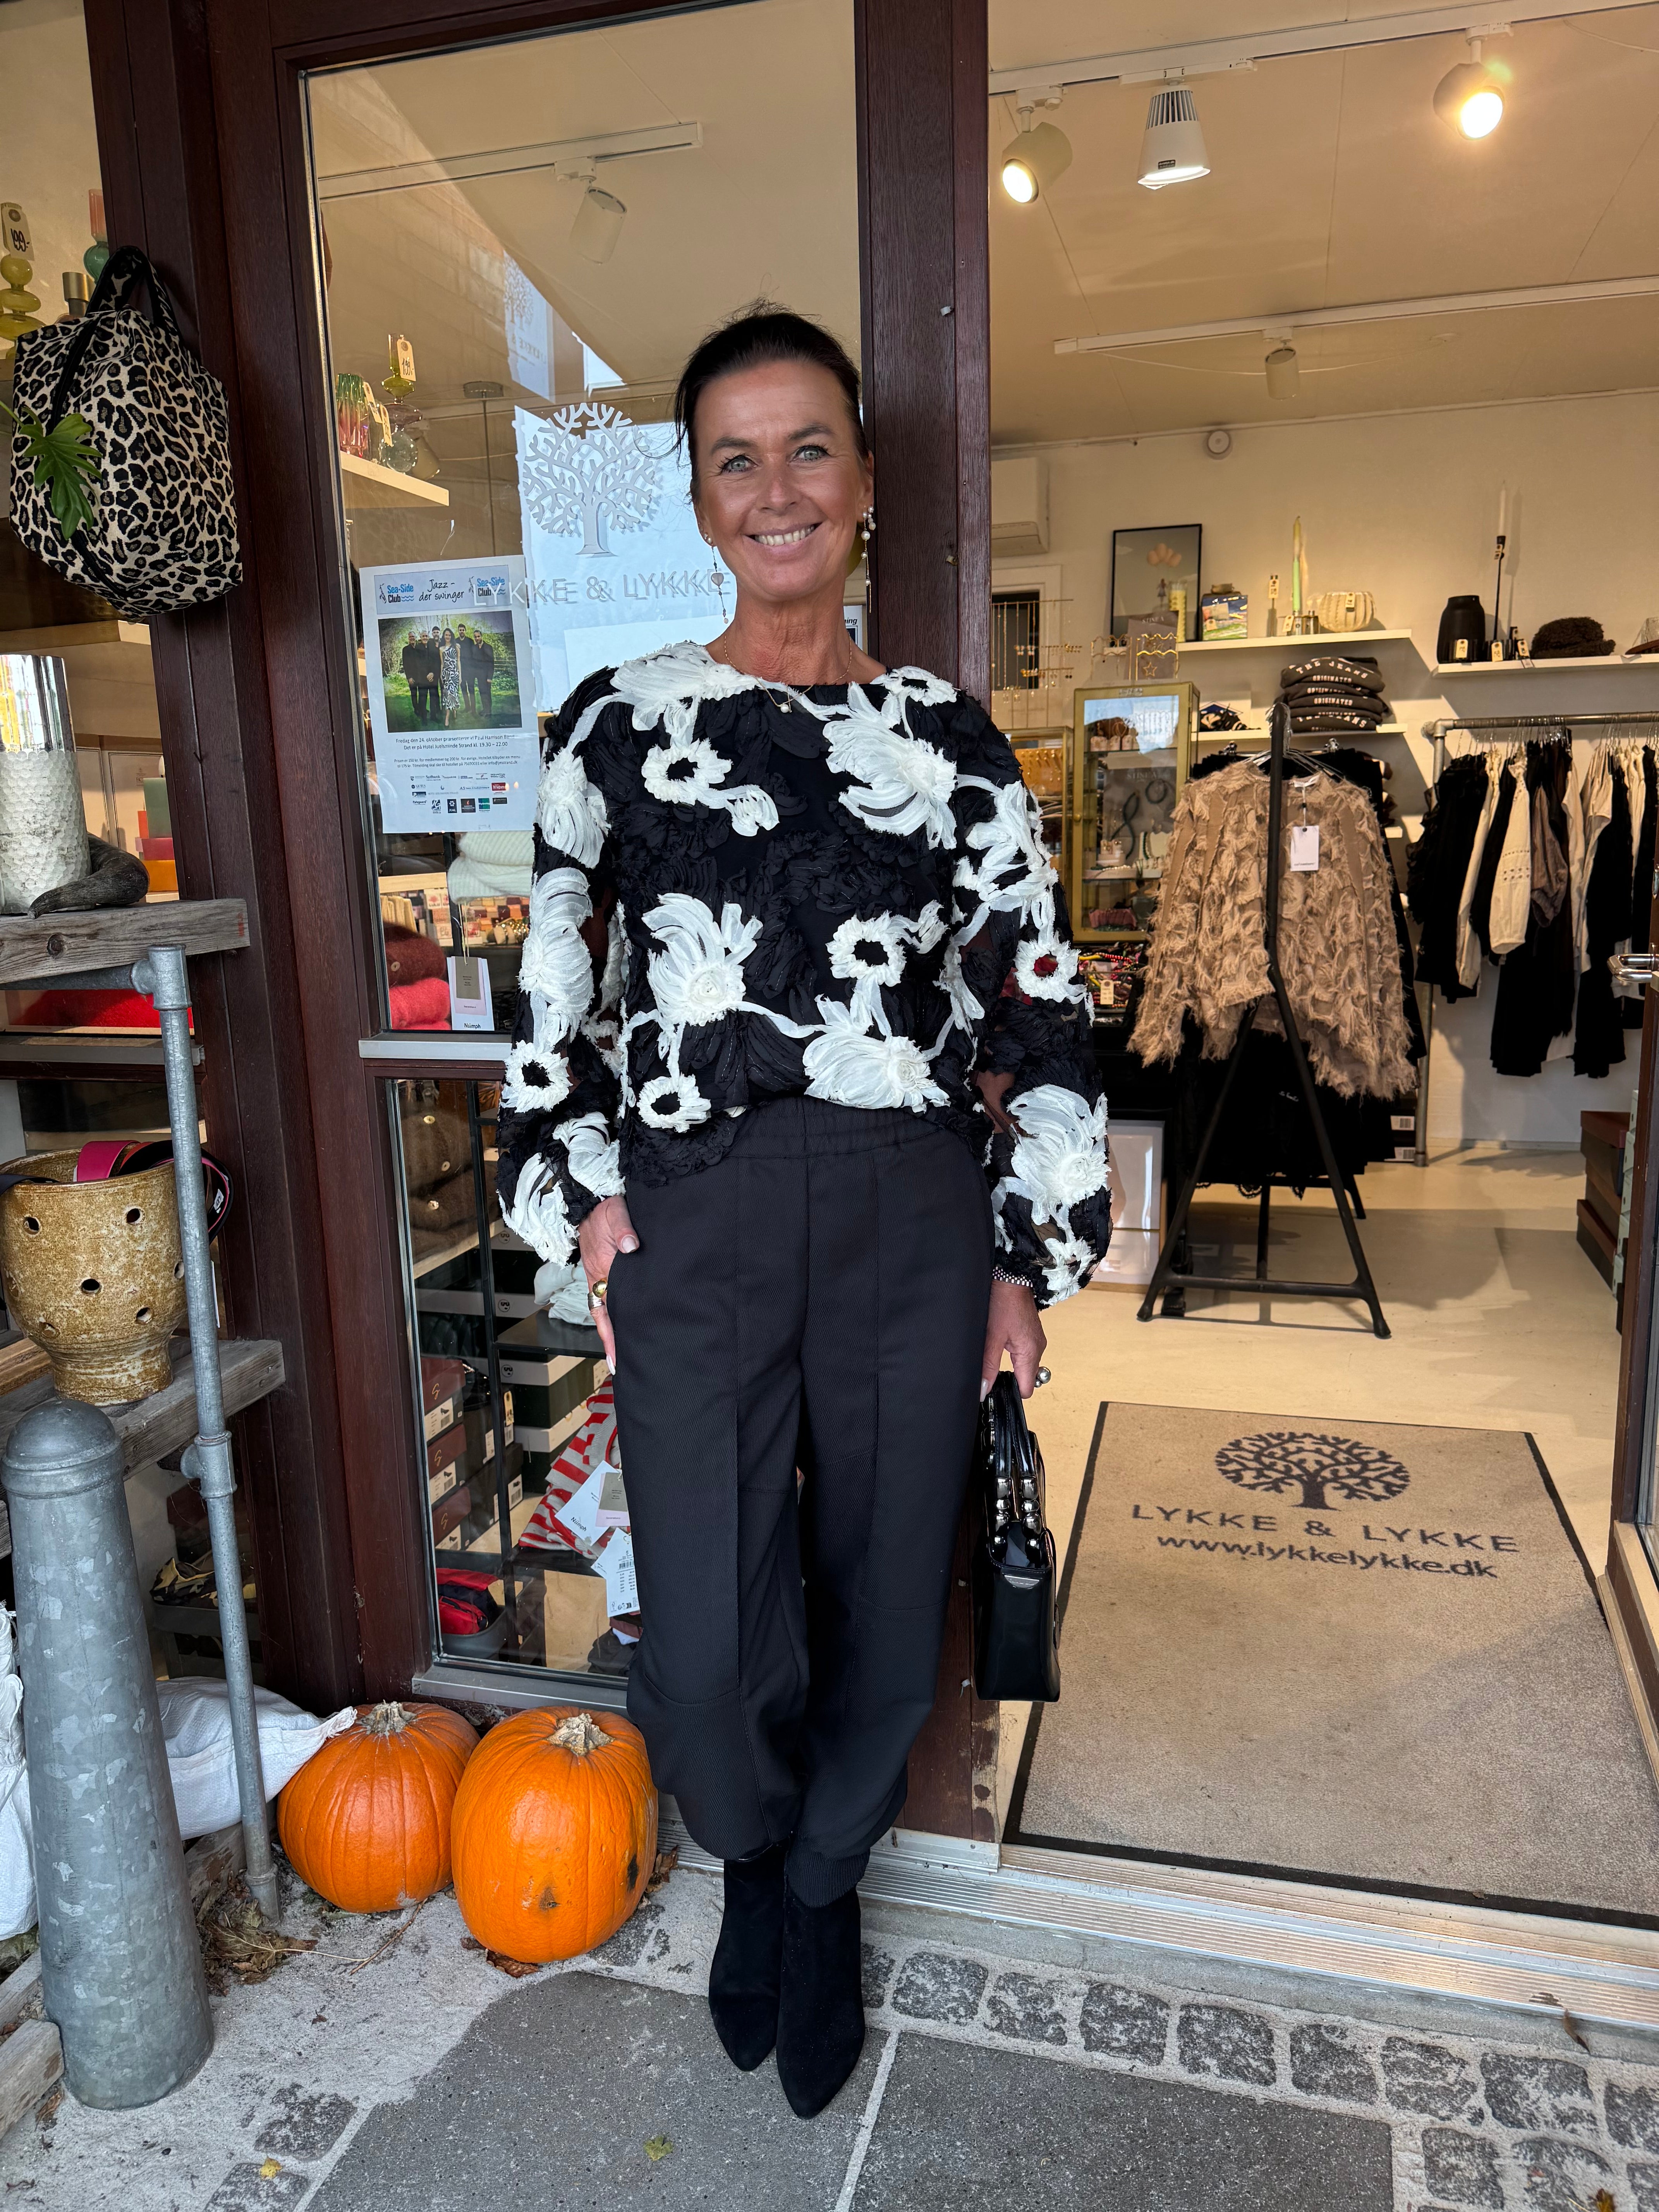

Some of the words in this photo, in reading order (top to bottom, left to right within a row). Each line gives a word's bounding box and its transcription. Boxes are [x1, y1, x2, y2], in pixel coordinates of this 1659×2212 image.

[427, 579, 448, 592] Jazz
[477, 577, 505, 587] Sea-Side
[387, 584, 414, 594] Sea-Side
[473, 578, 567, 606] LYKKE
[586, 576, 602, 600] &
[477, 587, 492, 597] Club
[388, 594, 401, 603] Club
[419, 593, 432, 601] der
[434, 591, 464, 603] swinger
[1296, 661, 1320, 674] THE
[1329, 661, 1368, 678] JEANS
[1314, 697, 1353, 706] ORIGINATED
[1132, 1504, 1277, 1531] LYKKE
[1304, 1520, 1336, 1537] &
[1362, 1525, 1520, 1552] LYKKE
[1158, 1536, 1498, 1578] www.lykkelykke.dk
